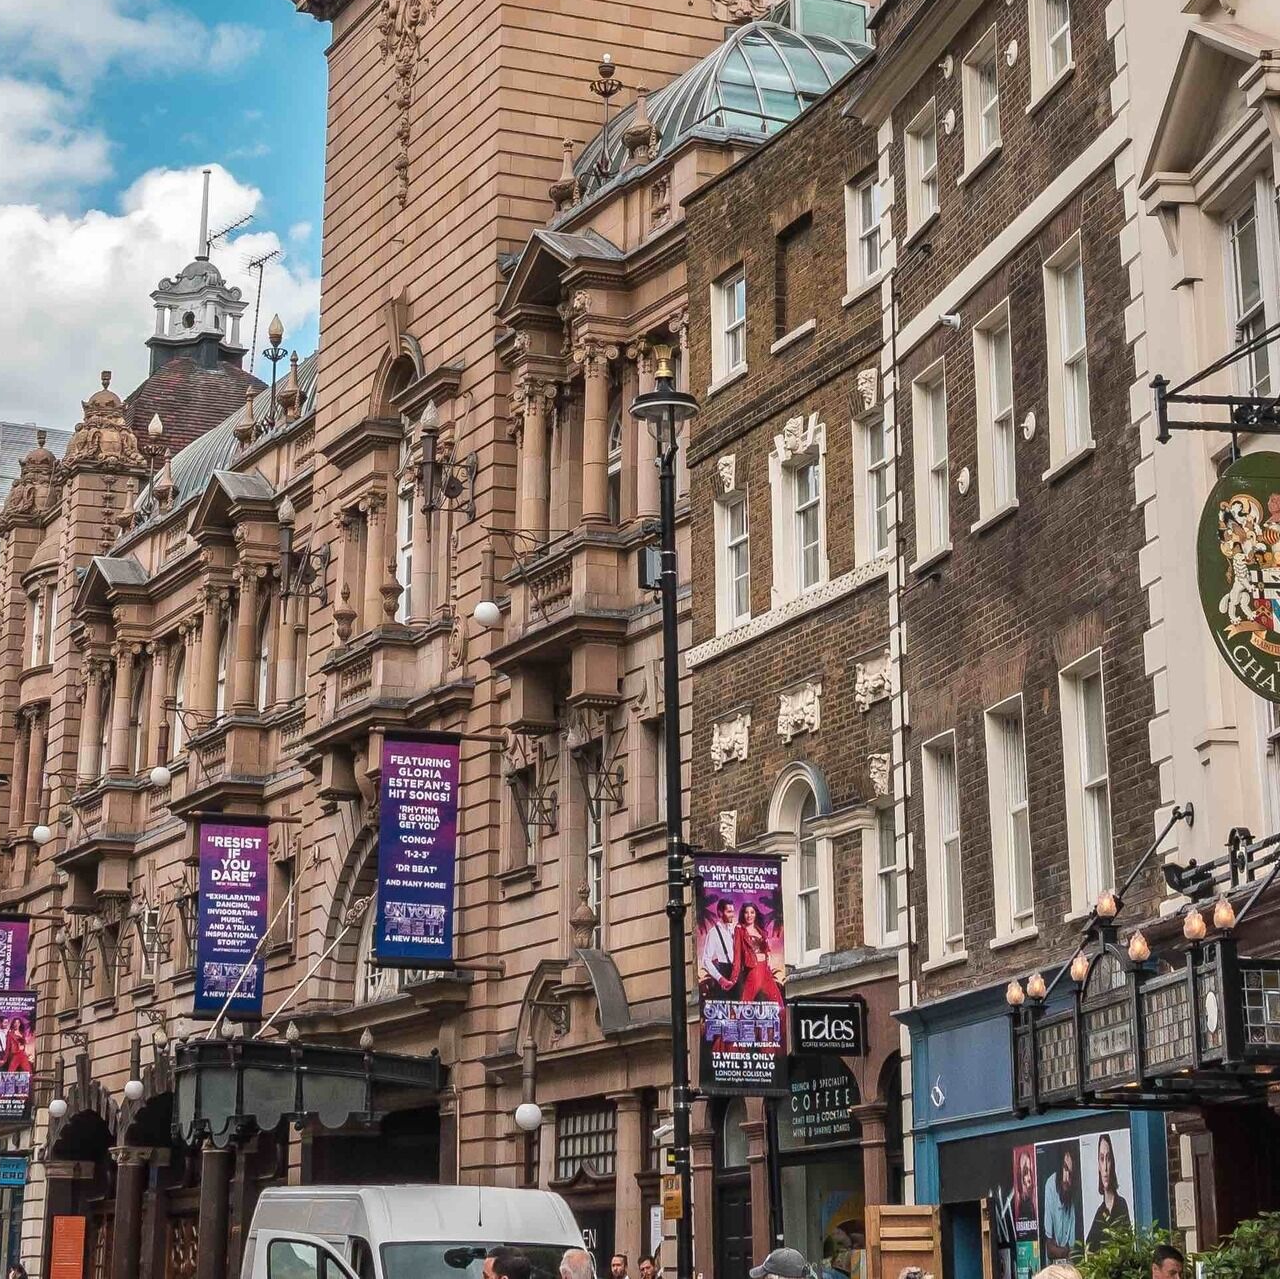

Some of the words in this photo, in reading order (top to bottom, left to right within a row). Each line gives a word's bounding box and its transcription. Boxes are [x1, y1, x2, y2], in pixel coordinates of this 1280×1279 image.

[390, 755, 451, 768] FEATURING
[398, 767, 441, 779] GLORIA
[388, 777, 451, 791] ESTEFAN'S
[388, 789, 407, 799] HIT
[409, 790, 450, 802] SONGS!
[399, 813, 407, 821] IS
[408, 814, 440, 823] GONNA
[399, 821, 416, 829] GET
[207, 835, 262, 849] "RESIST
[400, 835, 435, 845] 'CONGA'
[228, 848, 241, 859] IF
[220, 858, 251, 871] YOU
[698, 865, 731, 873] GLORIA
[732, 866, 778, 875] ESTEFAN'S
[211, 869, 256, 882] DARE"
[728, 874, 766, 882] MUSICAL
[402, 880, 423, 888] MANY
[424, 881, 446, 889] MORE!
[207, 908, 258, 916] INVIGORATING
[205, 931, 258, 939] INSPIRATIONAL
[411, 936, 445, 944] MUSICAL
[703, 1003, 731, 1020] ON
[732, 1005, 780, 1021] YOUR
[705, 1019, 781, 1042] FEET!
[800, 1013, 854, 1040] notes
[712, 1051, 721, 1060] 12
[722, 1052, 750, 1060] WEEKS
[752, 1052, 775, 1061] ONLY
[712, 1061, 740, 1069] UNTIL
[742, 1061, 752, 1069] 31
[755, 1061, 775, 1070] AUG
[791, 1088, 850, 1113] COFFEE
[821, 1108, 850, 1121] COCKTAILS
